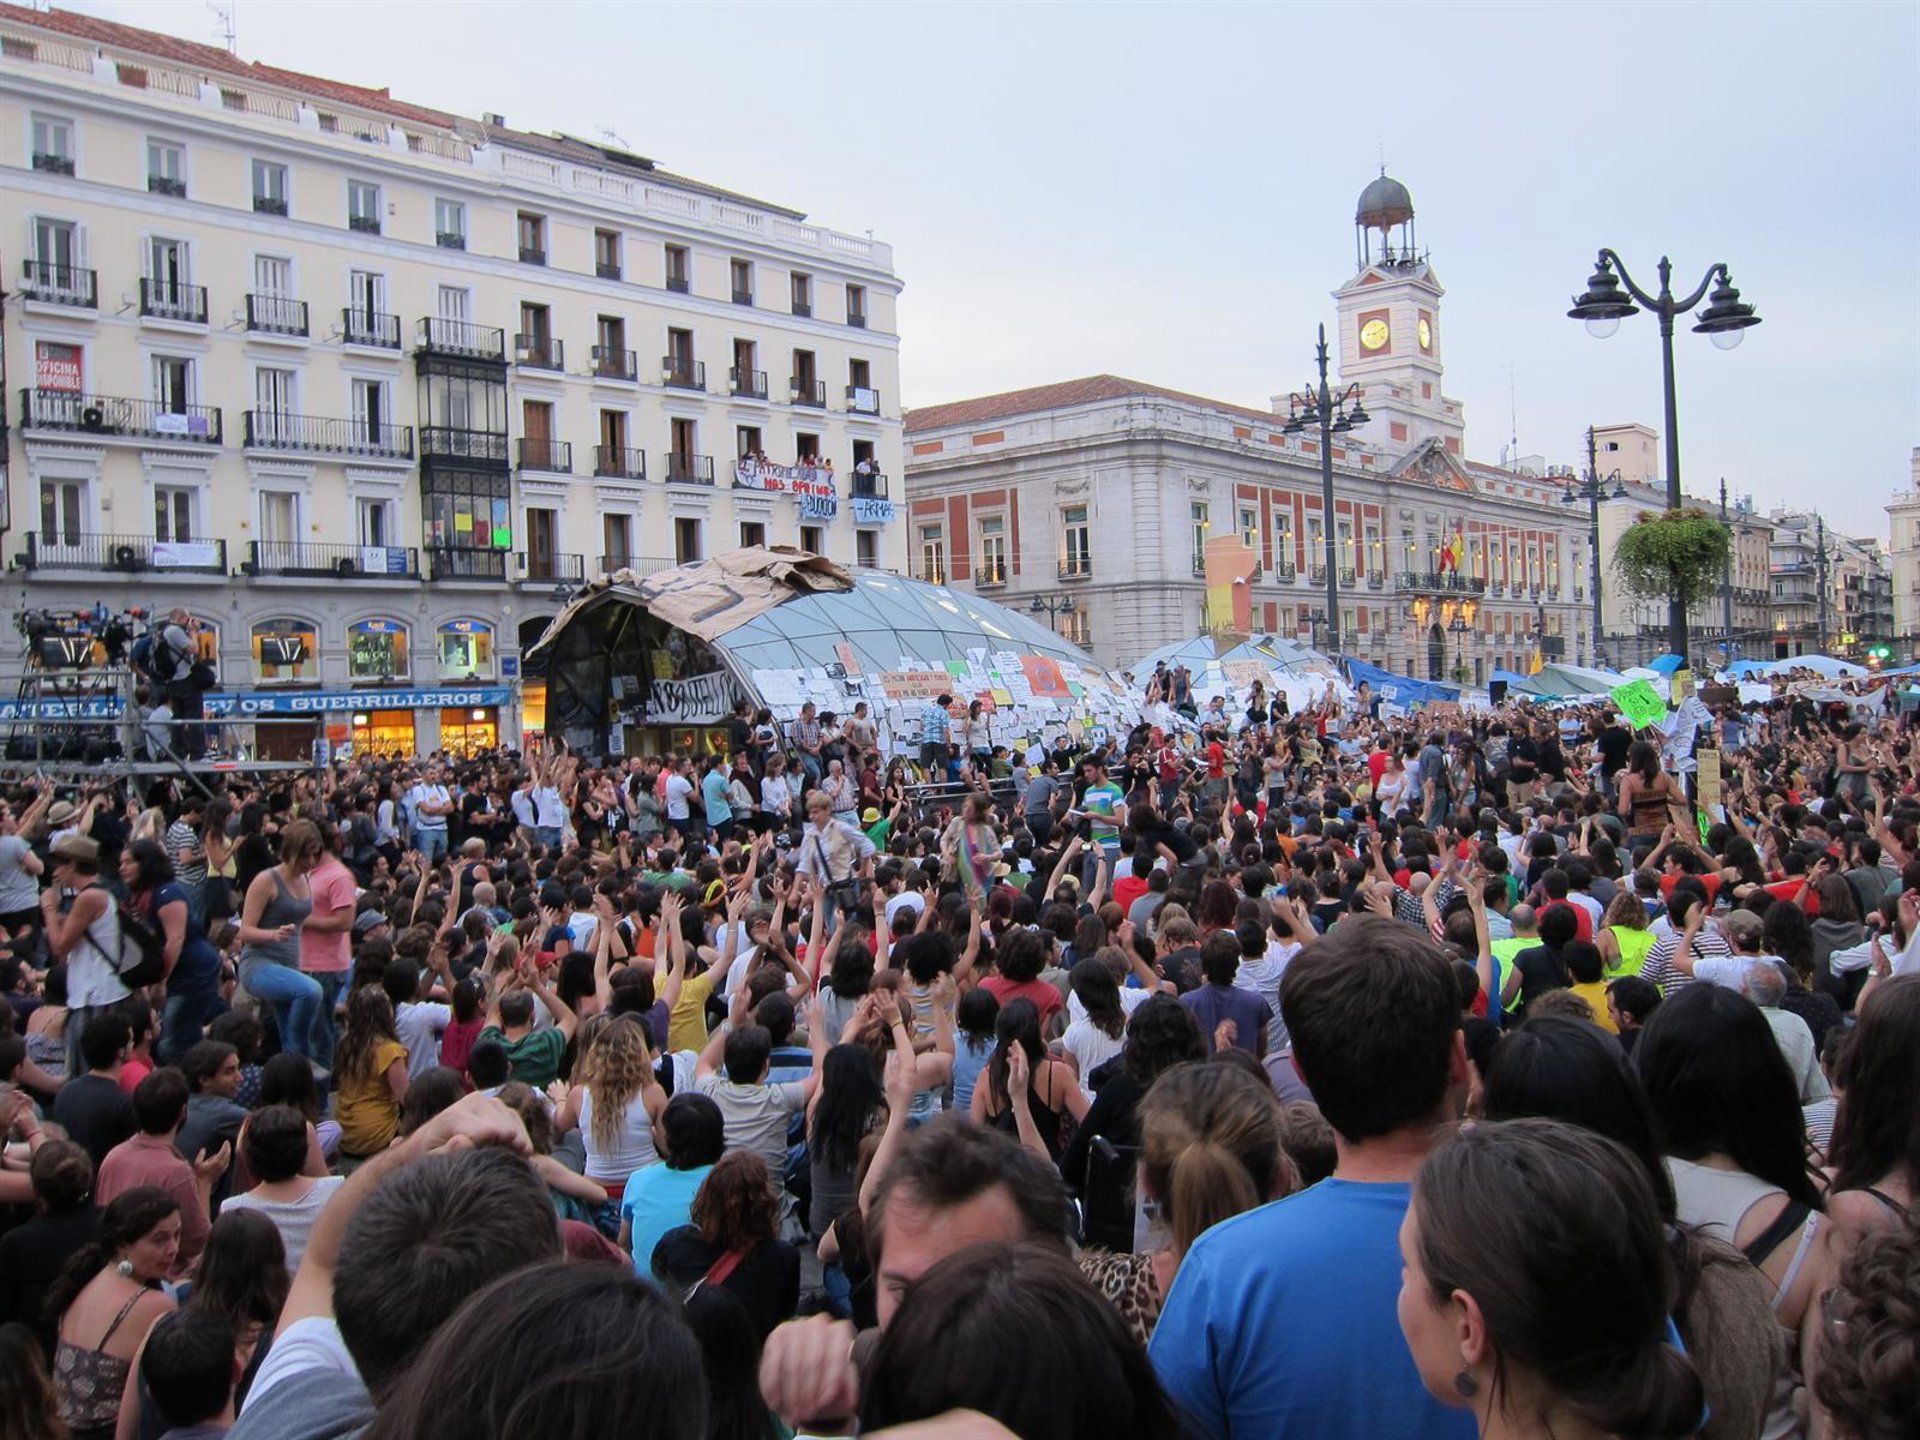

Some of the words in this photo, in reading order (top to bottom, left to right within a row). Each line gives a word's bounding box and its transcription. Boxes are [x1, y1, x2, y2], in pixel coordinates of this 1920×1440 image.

[36, 360, 79, 376] OFICINA
[290, 692, 482, 710] GUERRILLEROS
[653, 682, 680, 714] NO
